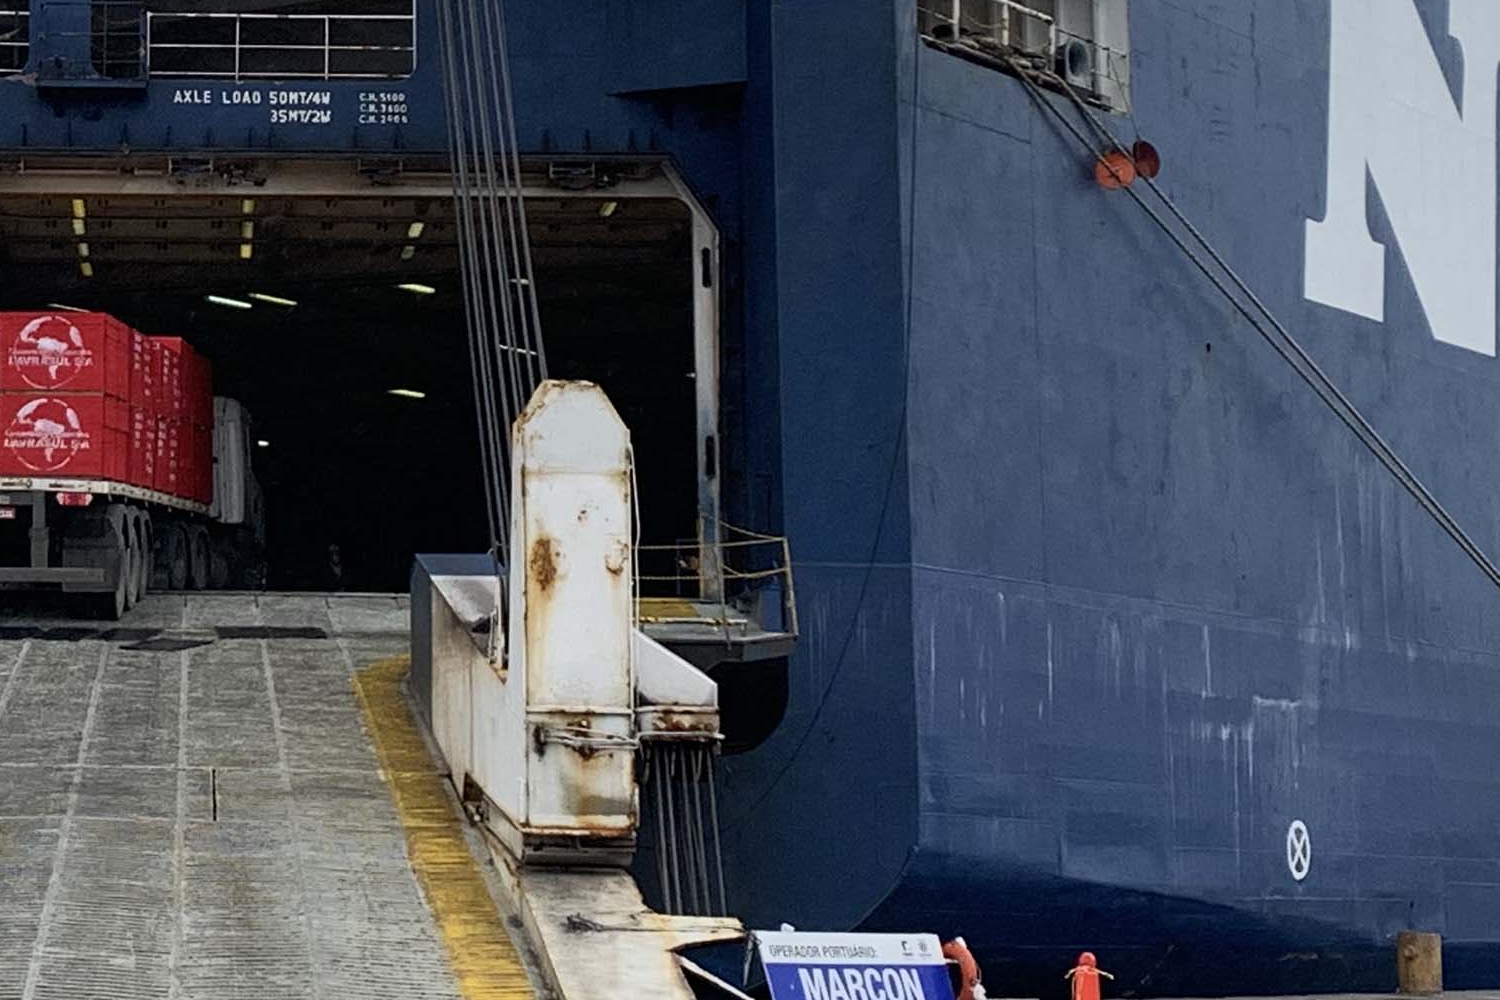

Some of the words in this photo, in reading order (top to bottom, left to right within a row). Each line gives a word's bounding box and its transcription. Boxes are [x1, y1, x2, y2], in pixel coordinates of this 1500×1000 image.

[173, 90, 211, 104] AXLE
[222, 90, 261, 104] LOAD
[269, 91, 331, 105] 50MT/4W
[270, 109, 331, 123] 35MT/2W
[768, 944, 820, 958] OPERADOR
[797, 967, 927, 1000] MARCON
